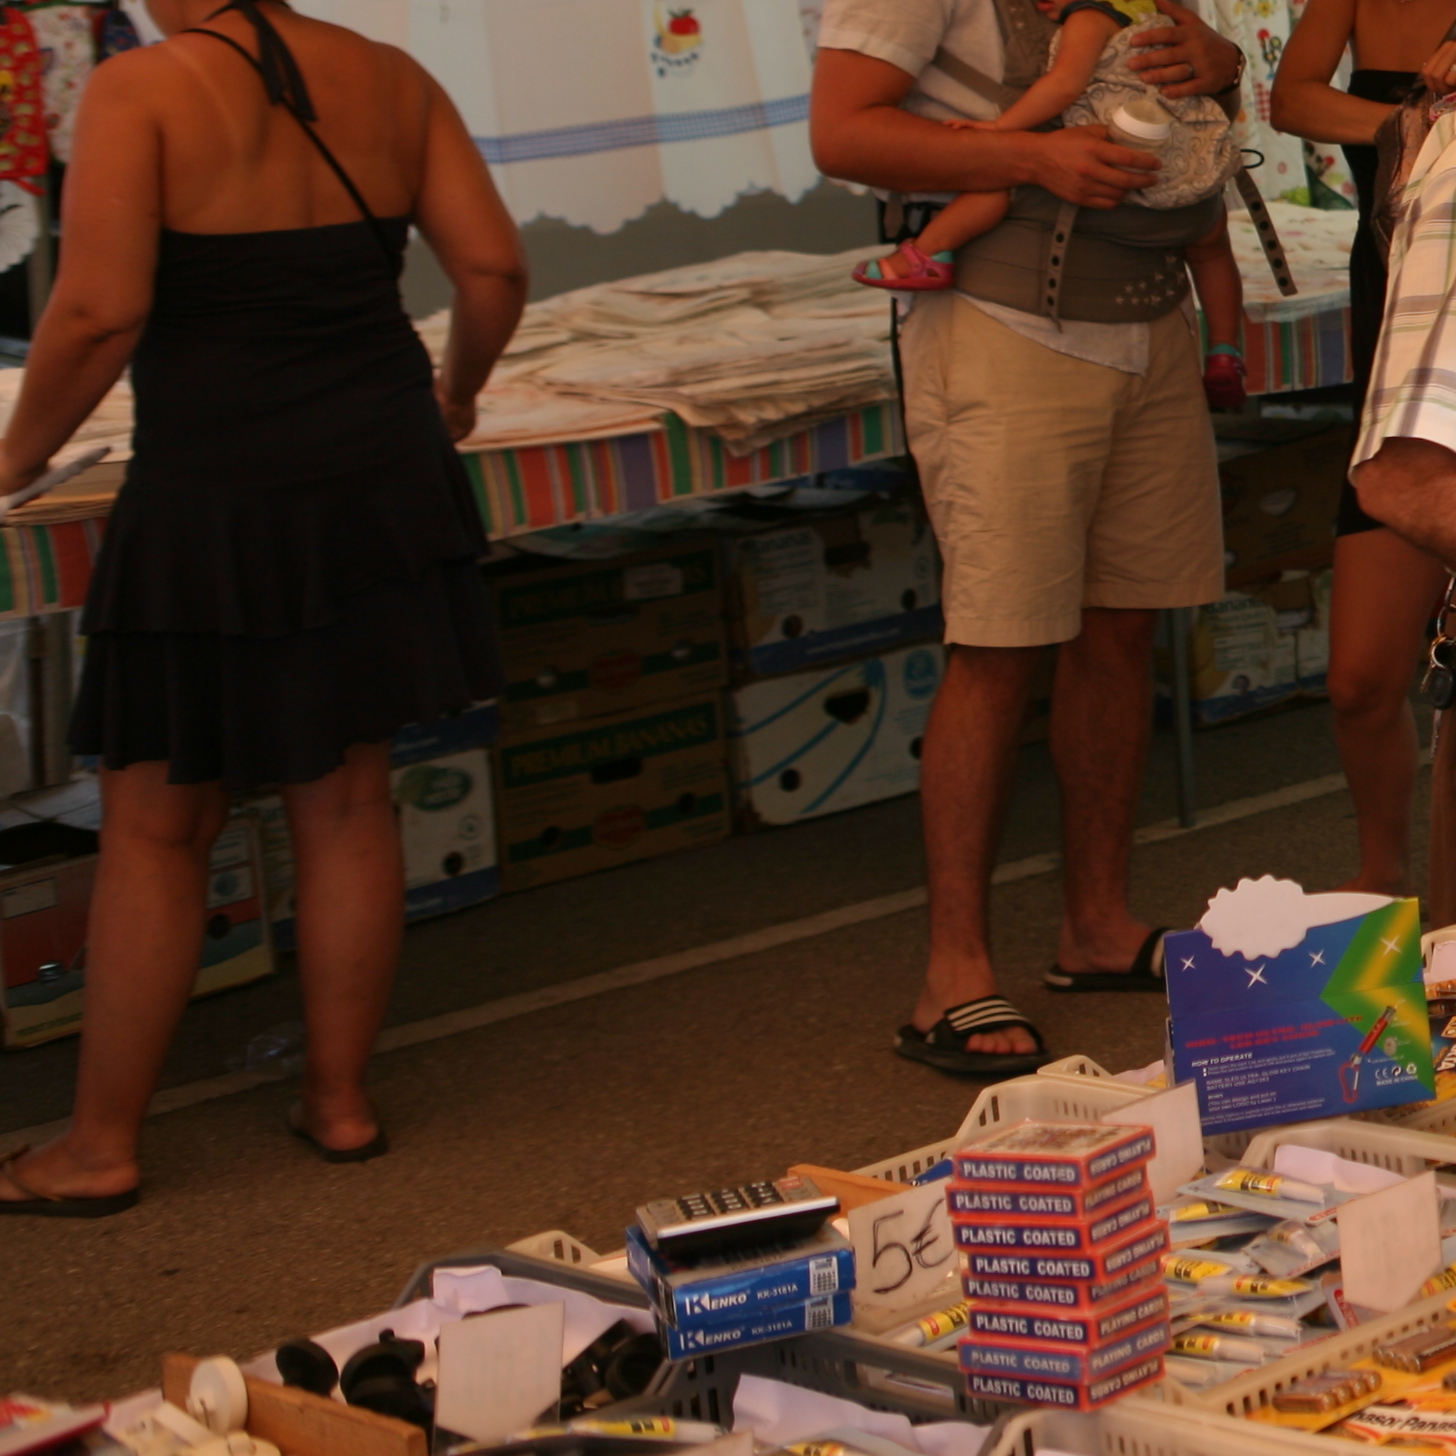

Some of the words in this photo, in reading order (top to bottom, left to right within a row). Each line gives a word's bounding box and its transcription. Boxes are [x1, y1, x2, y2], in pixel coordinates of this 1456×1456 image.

[1219, 1052, 1253, 1063] OPERATE
[963, 1161, 1017, 1180] PLASTIC
[1024, 1163, 1077, 1183] COATED
[956, 1194, 1013, 1212] PLASTIC
[1019, 1195, 1073, 1214] COATED
[872, 1197, 956, 1296] 5€
[961, 1228, 1017, 1246] PLASTIC
[1023, 1229, 1076, 1248] COATED
[975, 1258, 1031, 1275] PLASTIC
[1037, 1259, 1091, 1278] COATED
[684, 1291, 748, 1316] KENKO
[968, 1279, 1020, 1299] PLASTIC
[1026, 1286, 1075, 1305] COATED
[679, 1328, 743, 1351] KENKO
[976, 1315, 1028, 1335] PLASTIC
[1034, 1321, 1085, 1341] COATED
[971, 1351, 1018, 1368] PLASTIC
[1024, 1356, 1070, 1374] COATED
[973, 1376, 1021, 1397] PLASTIC
[1027, 1383, 1075, 1405] COATED
